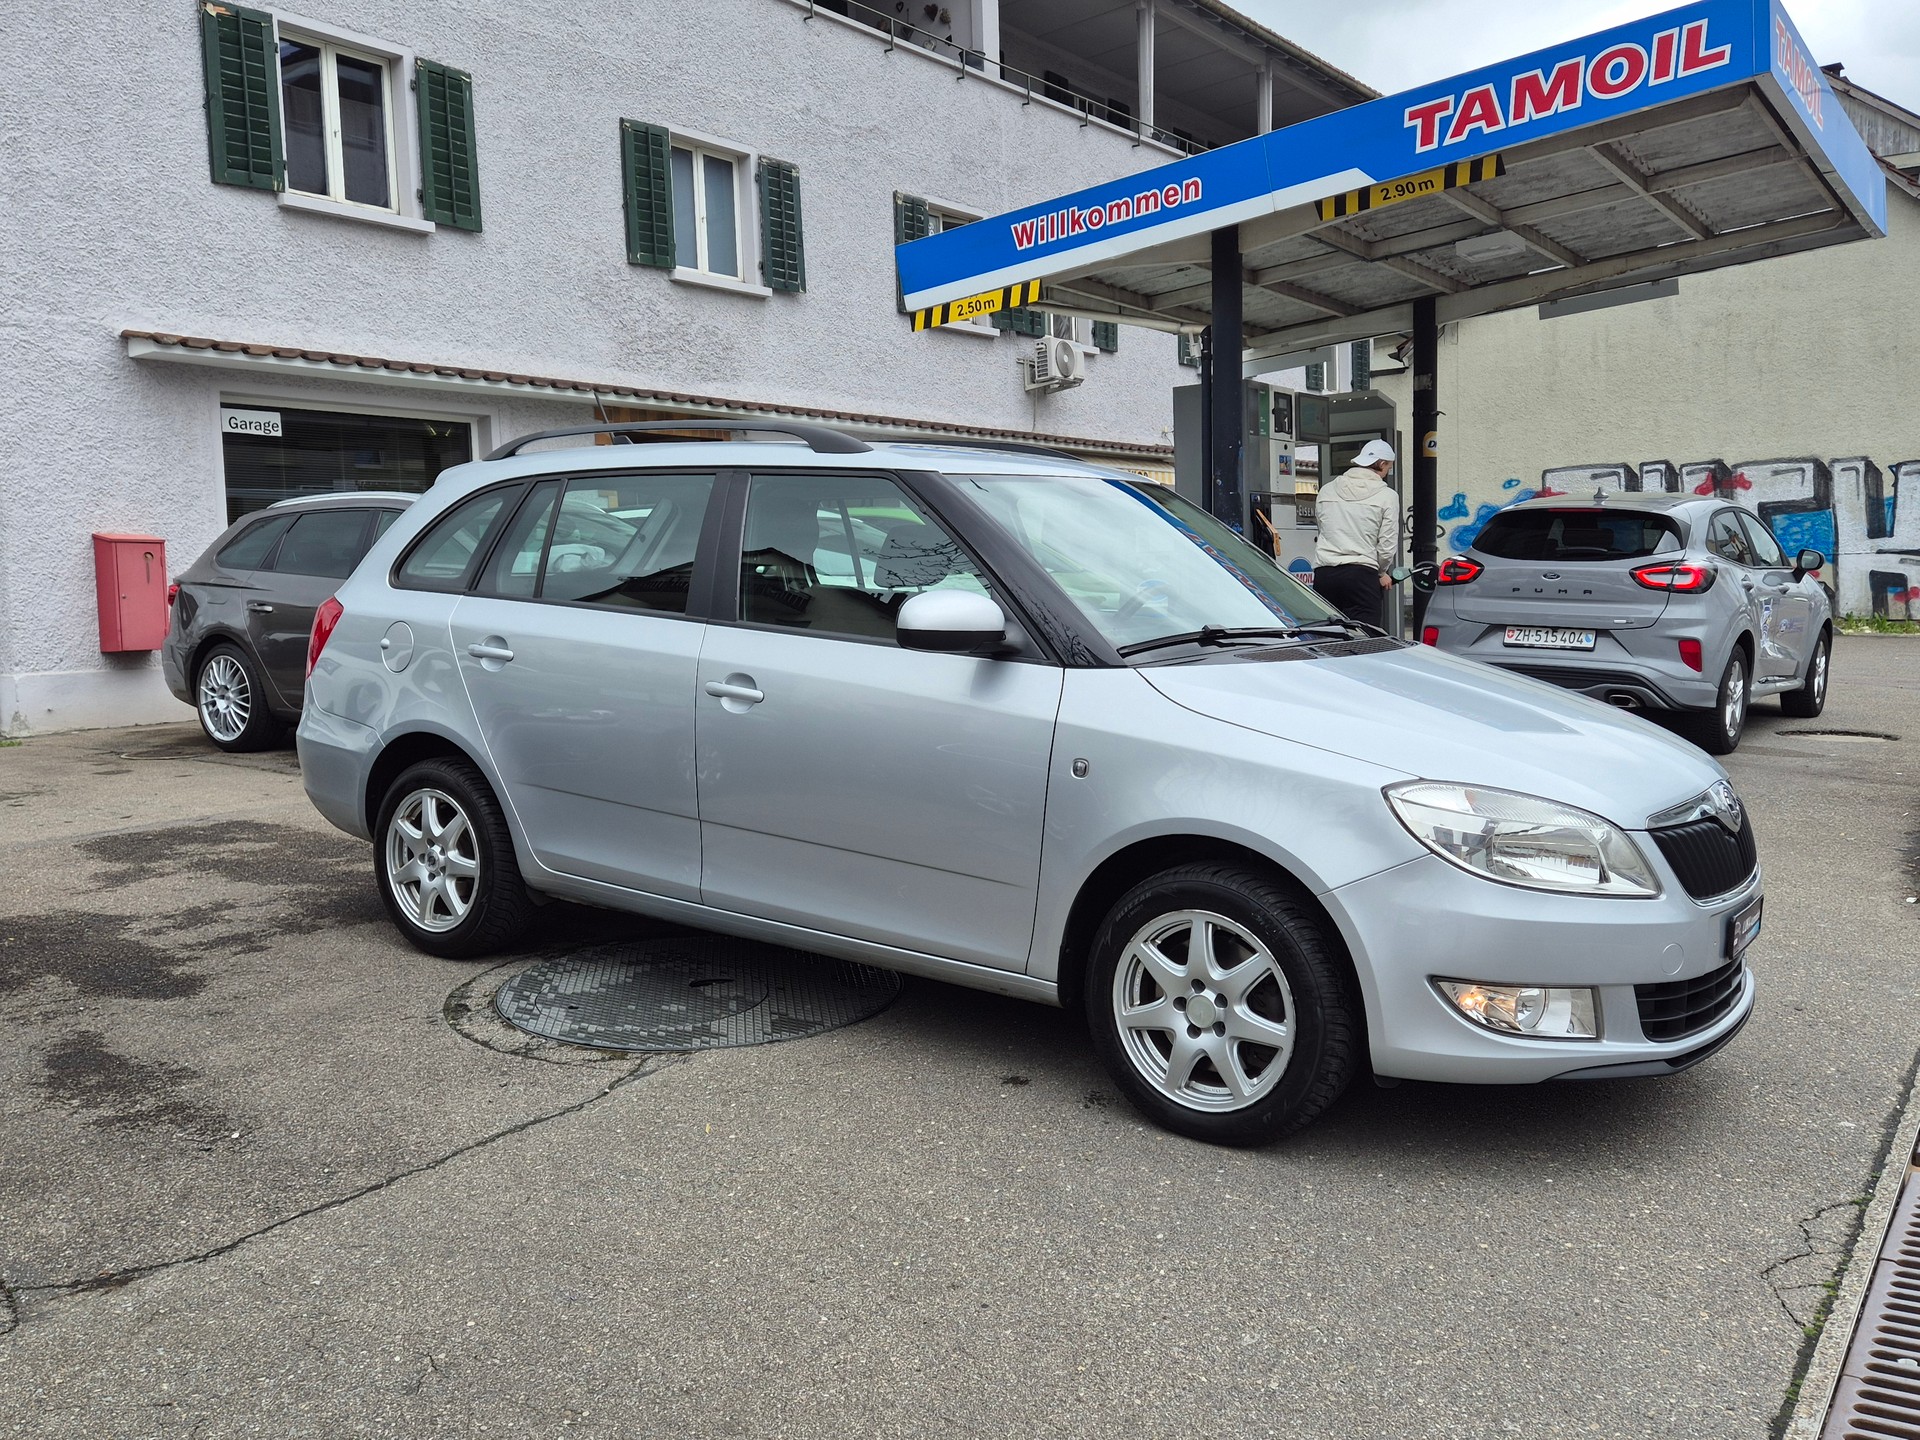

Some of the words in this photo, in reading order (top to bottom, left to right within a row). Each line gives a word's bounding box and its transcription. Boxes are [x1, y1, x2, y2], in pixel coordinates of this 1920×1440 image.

[1775, 14, 1824, 131] TAMOIL
[1404, 18, 1732, 153] TAMOIL
[1380, 181, 1416, 201] 2.90
[1418, 179, 1435, 192] m
[1011, 177, 1202, 250] Willkommen
[957, 299, 982, 317] 2.50
[984, 299, 995, 310] m
[228, 416, 280, 435] Garage
[1512, 587, 1593, 595] PUMA
